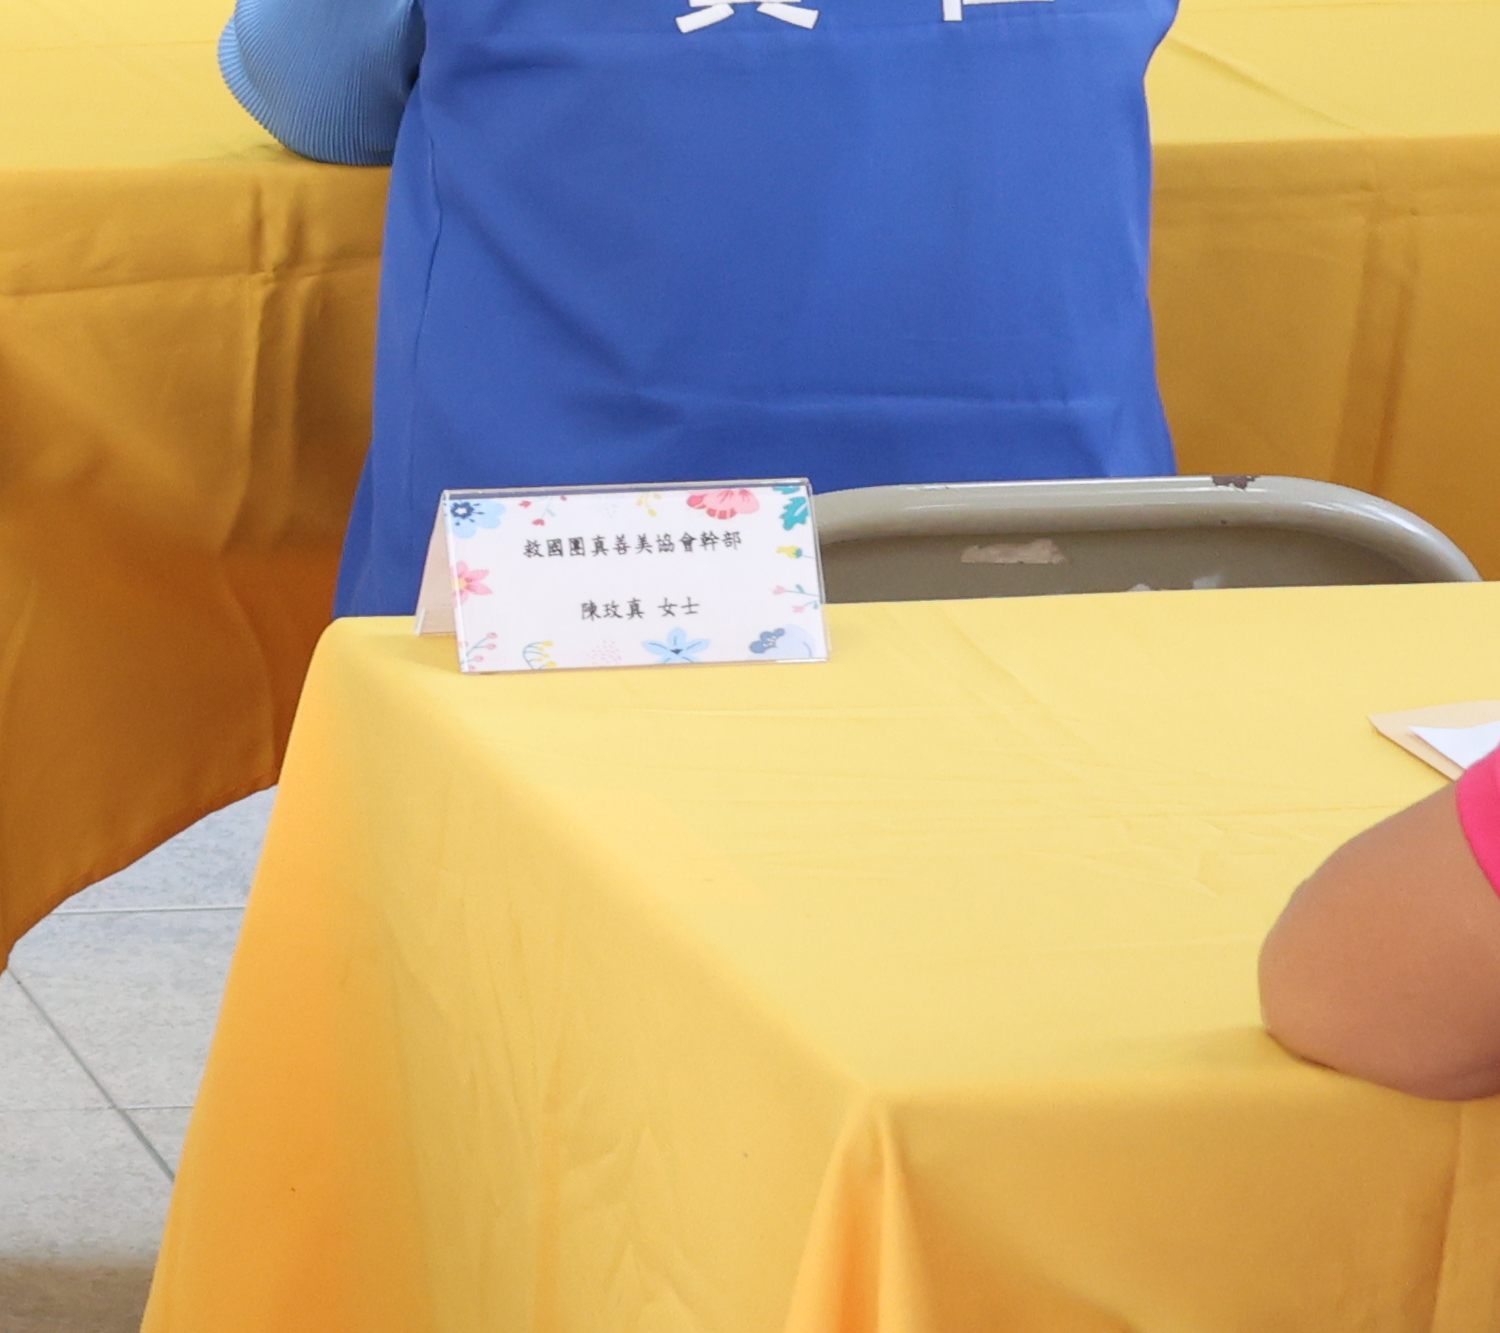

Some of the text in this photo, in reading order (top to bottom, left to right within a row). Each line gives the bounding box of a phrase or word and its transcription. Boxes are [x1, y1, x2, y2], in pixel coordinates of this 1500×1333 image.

[523, 529, 742, 560] 救國團真善美協會幹部
[658, 596, 700, 618] 女士
